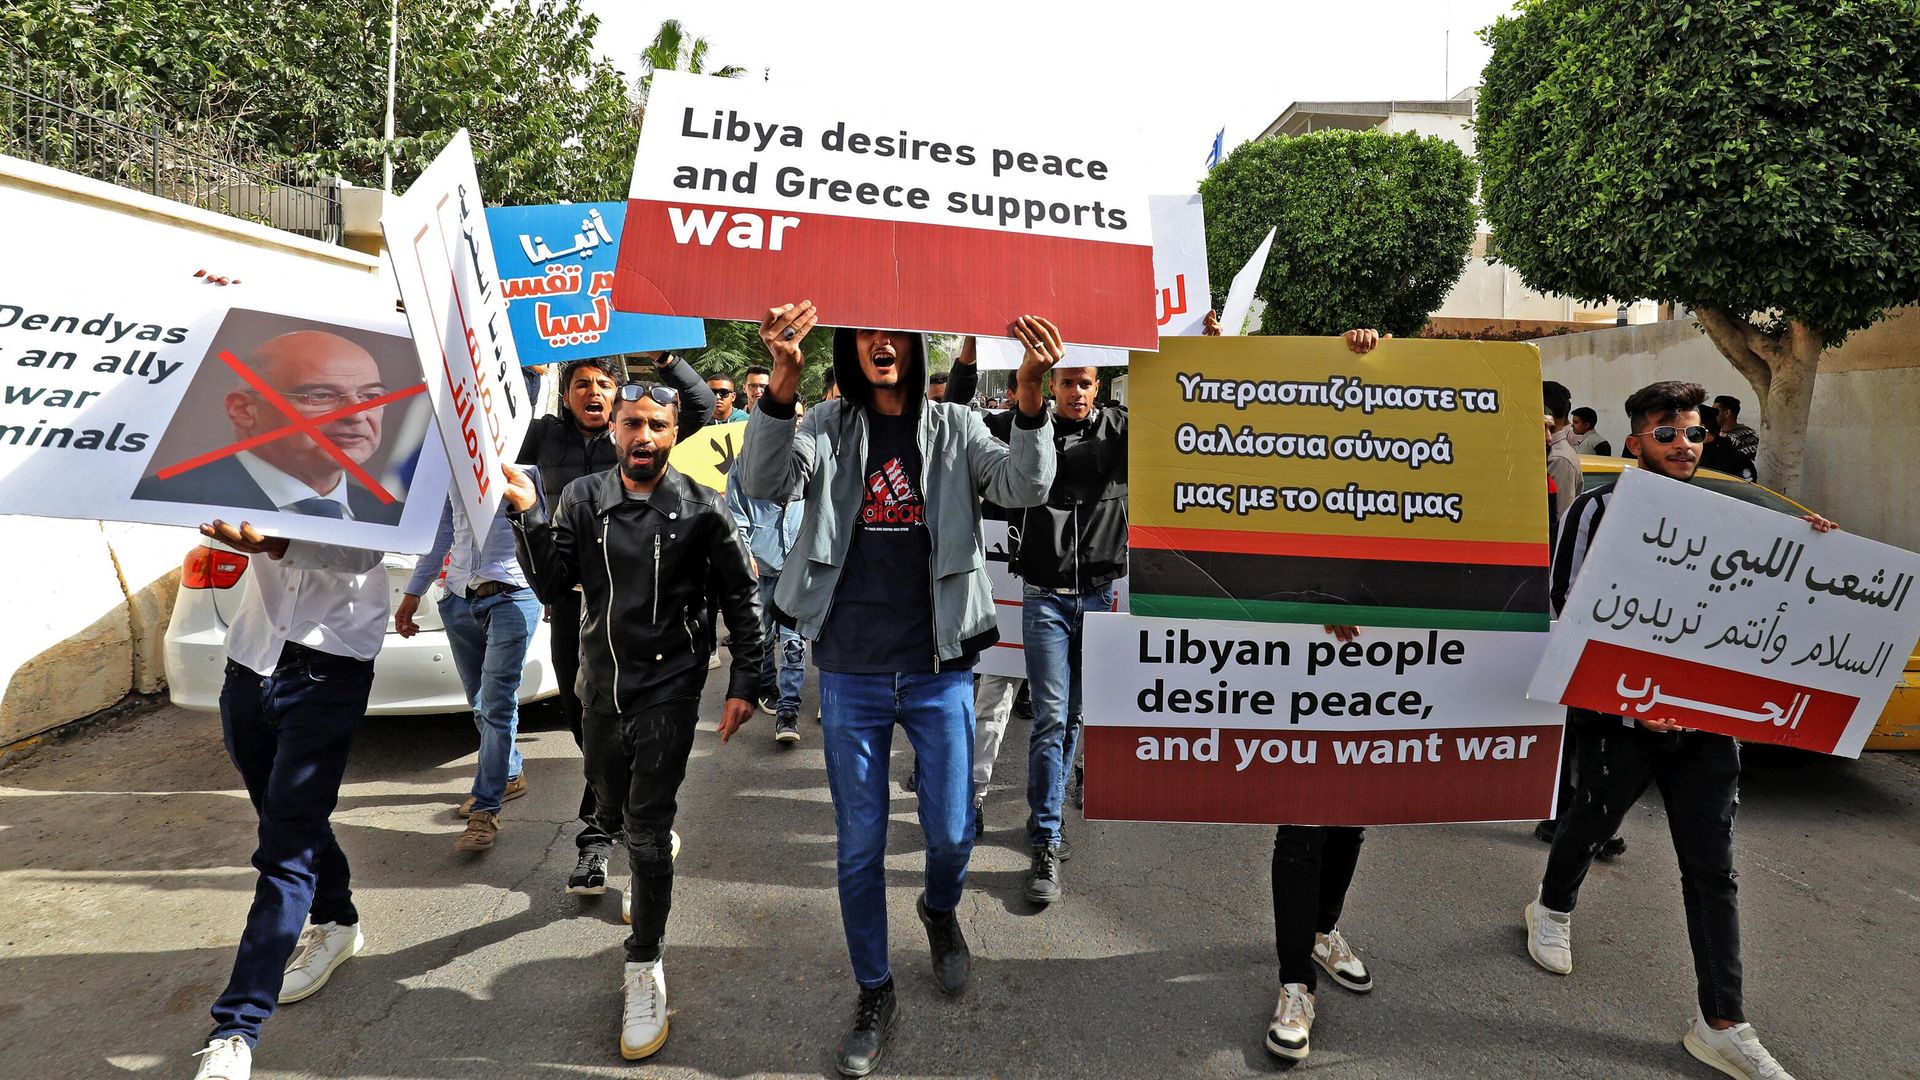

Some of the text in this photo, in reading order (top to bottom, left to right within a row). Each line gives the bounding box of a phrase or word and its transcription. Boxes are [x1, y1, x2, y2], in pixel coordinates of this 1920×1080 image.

[680, 106, 1109, 182] Libya desires peace
[673, 161, 1128, 231] and Greece supports
[519, 208, 613, 266] أثينا
[667, 207, 800, 252] war
[0, 304, 190, 344] Dendyas
[536, 297, 609, 346] ليبيا
[17, 350, 184, 385] an ally
[5, 386, 101, 409] war
[1177, 374, 1498, 413] Υπερασπιζόμαστε τα
[1176, 427, 1452, 467] θαλάσσια σύνορά
[1176, 483, 1461, 521] μας με το αίμα μας
[1642, 516, 1914, 613] الشعب الليبي يريد
[1138, 629, 1466, 676] Libyan people
[1592, 583, 1894, 679] السلام وأنتم تريدون
[1136, 678, 1434, 725] desire peace,
[1615, 673, 1811, 731] الحرب
[1135, 728, 1537, 772] and you want war
